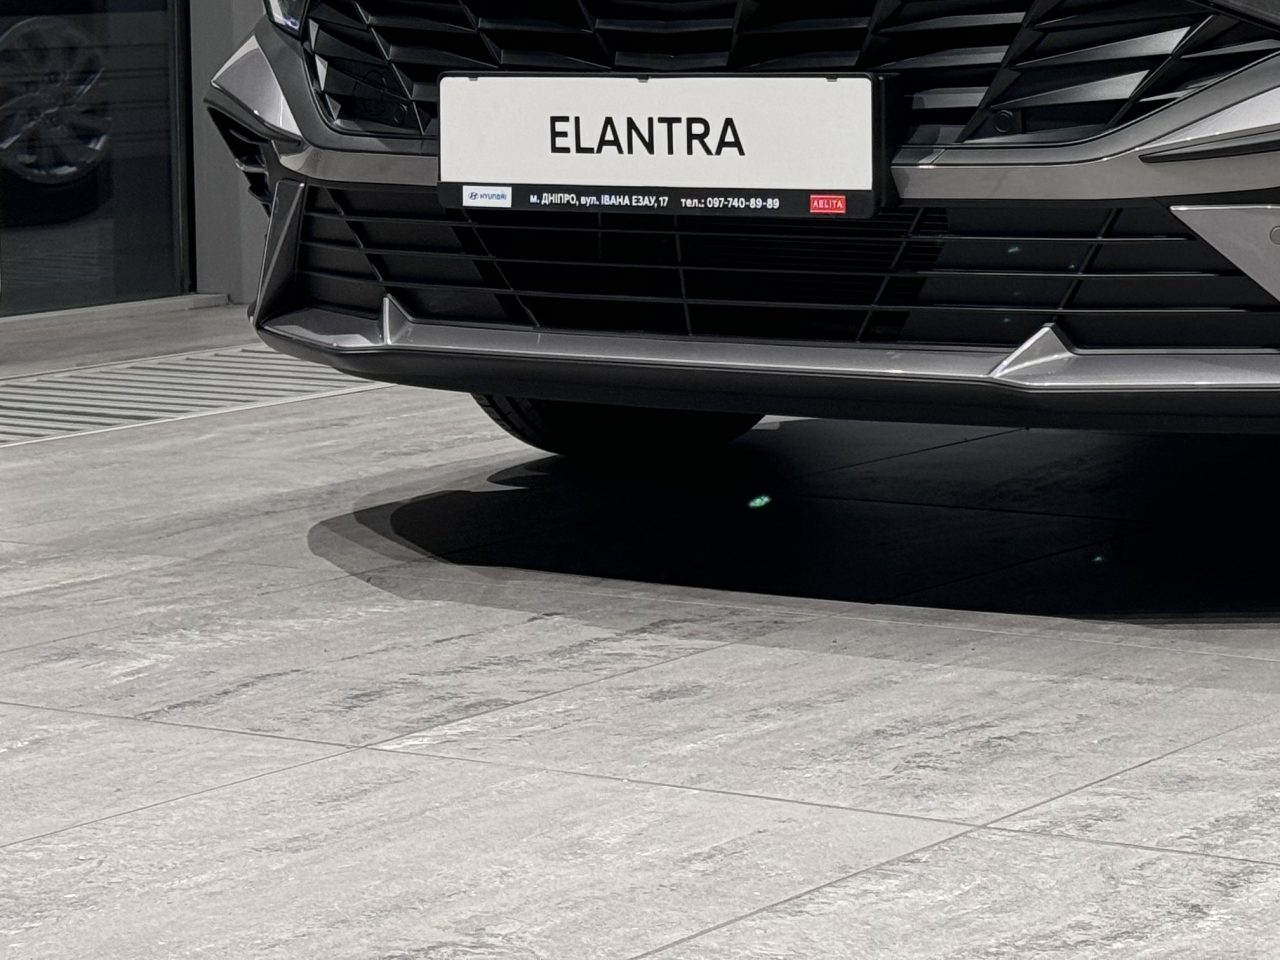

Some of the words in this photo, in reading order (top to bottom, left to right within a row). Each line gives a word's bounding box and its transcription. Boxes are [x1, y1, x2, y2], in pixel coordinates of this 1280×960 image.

[549, 116, 745, 156] ELANTRA
[480, 193, 507, 201] HYUNDAI
[530, 194, 540, 203] м.
[541, 193, 579, 206] ДНІПРО,
[580, 196, 599, 207] вул.
[601, 194, 631, 206] ІВАНА
[632, 196, 657, 208] ЕЗАУ,
[659, 196, 669, 207] 17
[680, 198, 705, 208] тел.:
[706, 197, 780, 209] 097-740-89-89
[812, 199, 843, 209] AELITA
